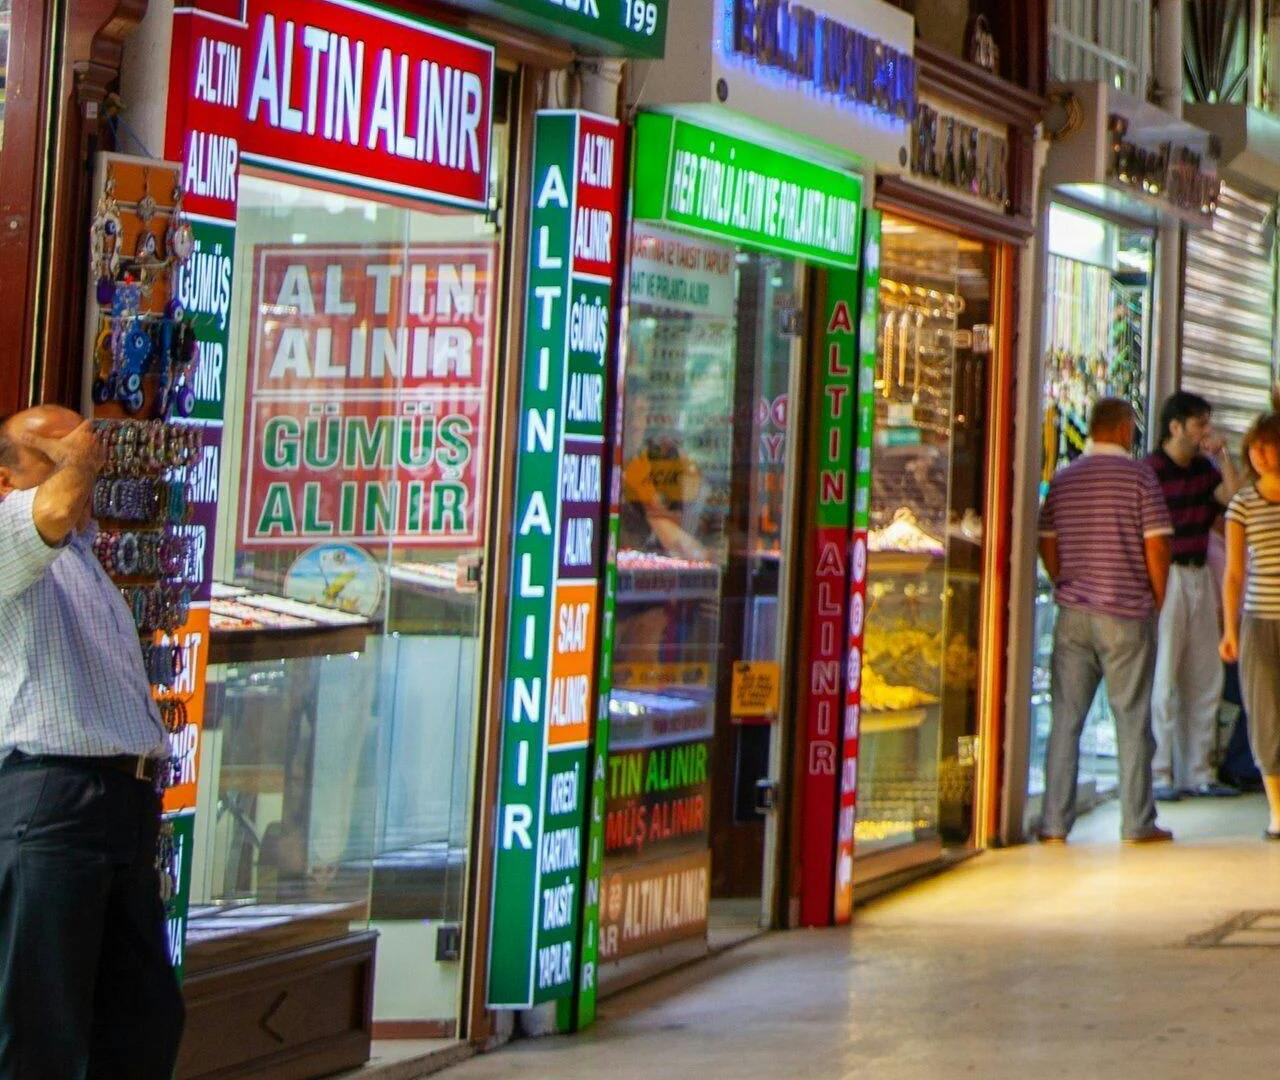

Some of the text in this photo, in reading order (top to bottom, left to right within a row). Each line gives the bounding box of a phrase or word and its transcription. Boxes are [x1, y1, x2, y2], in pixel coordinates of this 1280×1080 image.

[194, 35, 242, 109] ALTIN
[247, 13, 484, 174] ALTIN ALINIR
[183, 128, 239, 201] ALINIR
[580, 132, 615, 190] ALTIN
[671, 149, 698, 216] HER
[697, 141, 735, 226] TÜRLÜ
[731, 167, 766, 233] ALTIN
[764, 177, 780, 237] VE
[824, 195, 857, 256] ALINIR
[575, 206, 613, 263] ALINIR
[275, 263, 477, 316] ALTIN
[268, 326, 474, 379] ALINIR
[569, 292, 609, 367] GÜMÜŞ
[568, 372, 604, 422] ALINIR
[820, 300, 853, 505] ALTIN
[262, 402, 472, 481] GÜMÜŞ
[255, 480, 468, 537] ALINIR
[502, 164, 568, 850] ALTIN ALINIR
[563, 517, 593, 566] ALINIR
[557, 602, 591, 654] SAAT
[808, 541, 846, 776] ALINIR
[551, 674, 588, 727] ALINIR
[550, 761, 580, 816] KREDİ
[646, 741, 708, 795] ALINIR
[649, 794, 705, 841] ALINIR
[543, 876, 575, 931] TAKSİT
[623, 877, 663, 940] ALTIN
[663, 867, 708, 932] ALINIR
